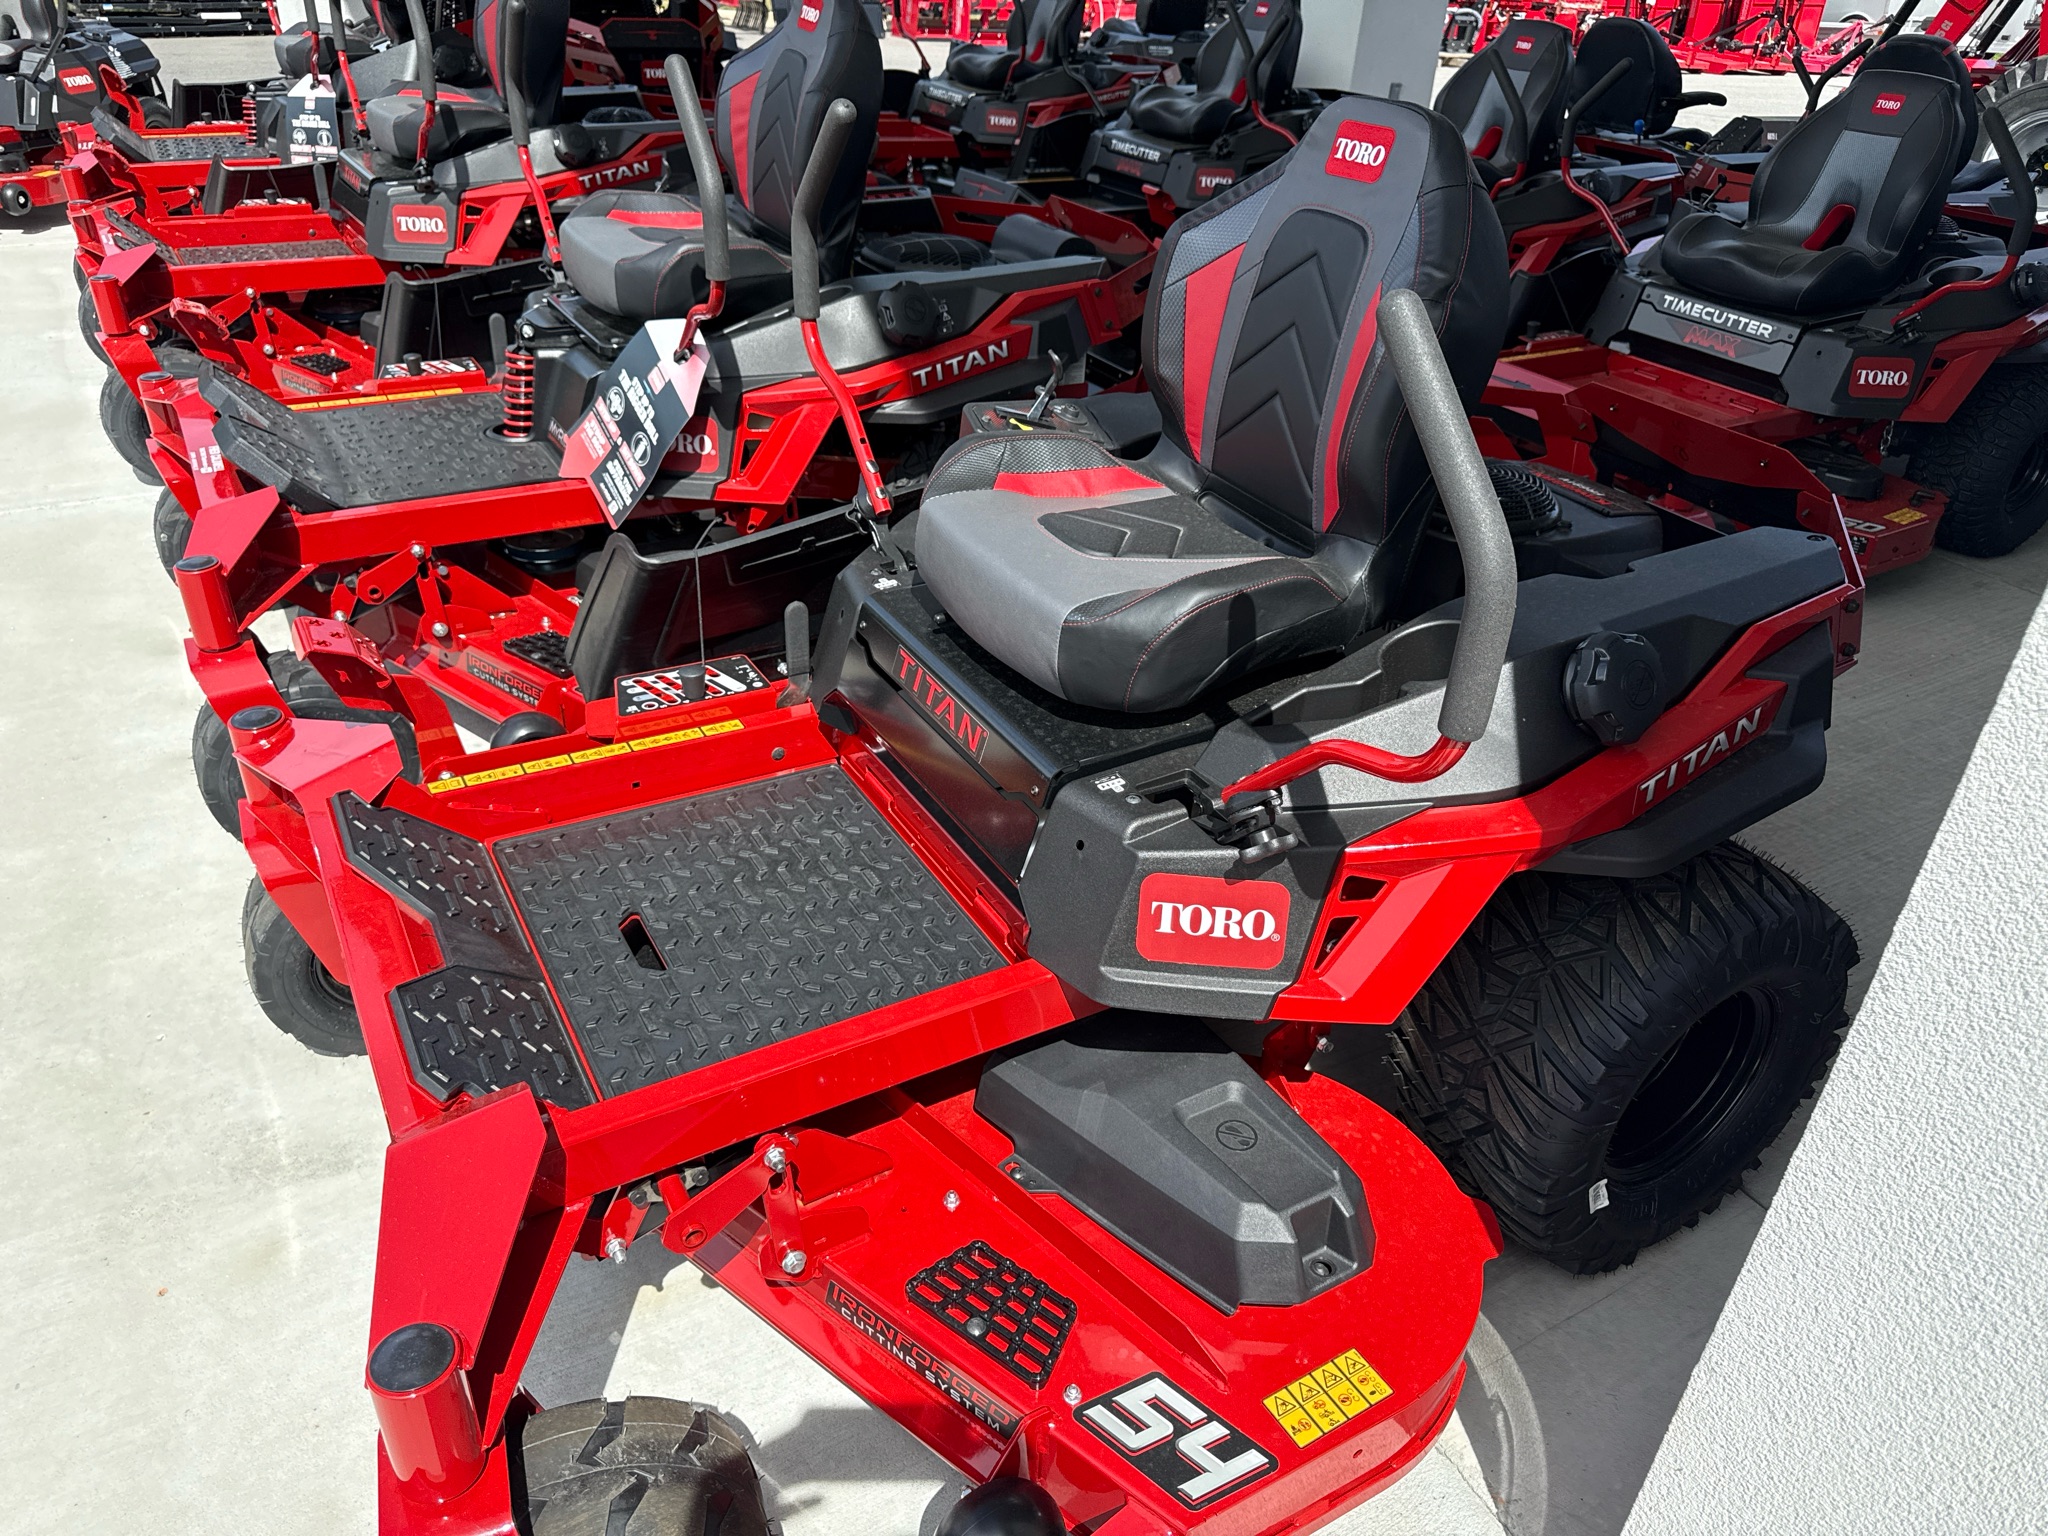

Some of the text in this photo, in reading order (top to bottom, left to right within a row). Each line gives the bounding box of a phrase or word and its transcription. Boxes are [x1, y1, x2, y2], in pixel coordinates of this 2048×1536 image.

[800, 4, 820, 23] TORO
[63, 74, 93, 88] TORO
[643, 68, 667, 79] TOR
[1876, 99, 1901, 110] TORO
[989, 114, 1017, 127] TORO
[1110, 139, 1162, 163] TIMECUTTER
[1334, 137, 1386, 167] TORO
[577, 160, 650, 189] TITAN
[396, 215, 446, 233] TORO
[1663, 294, 1774, 339] TIMECUTTER
[1683, 325, 1742, 359] MAX
[912, 339, 1009, 388] TITAN
[1856, 369, 1908, 386] TORO
[669, 433, 712, 455] RO
[469, 653, 541, 700] IRONFORGE
[473, 668, 510, 692] CUTTING
[899, 648, 985, 754] TITAN
[1639, 706, 1763, 804] TITAN
[1151, 901, 1277, 942] TORO
[832, 1286, 1014, 1426] IRONFORGED
[841, 1306, 1000, 1433] CUTTING SYSTEM
[1083, 1377, 1270, 1500] 54
